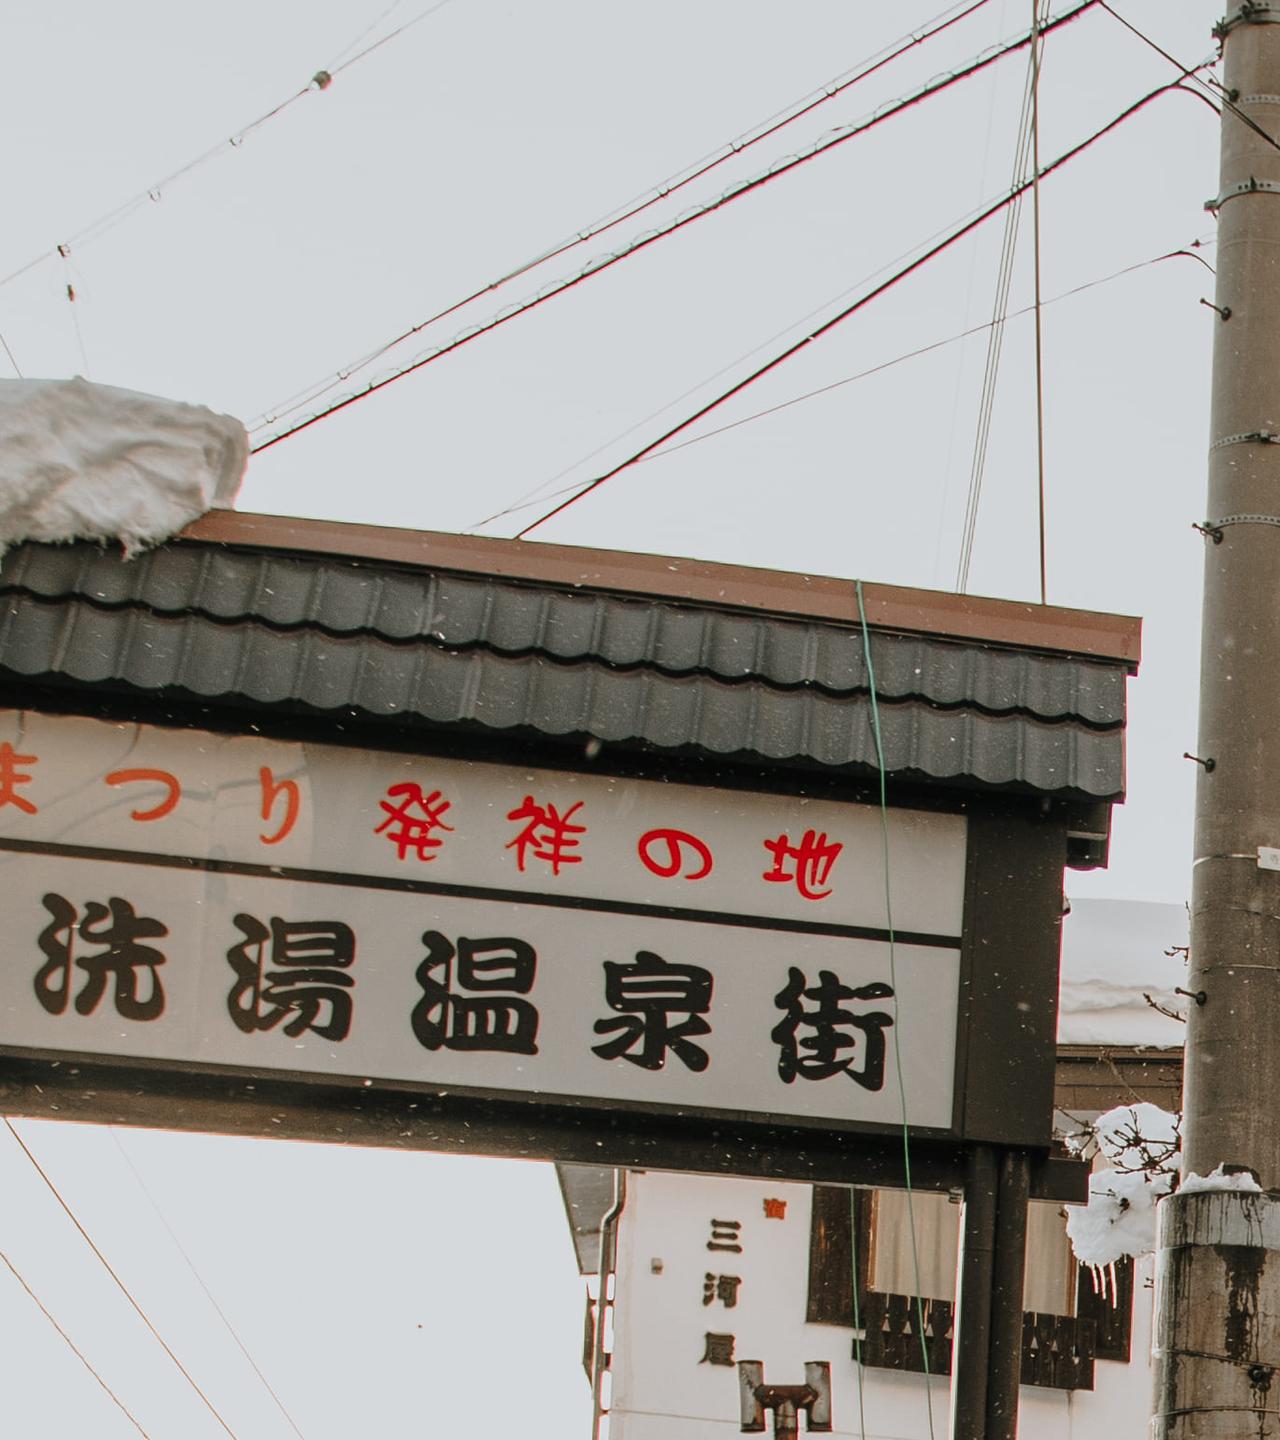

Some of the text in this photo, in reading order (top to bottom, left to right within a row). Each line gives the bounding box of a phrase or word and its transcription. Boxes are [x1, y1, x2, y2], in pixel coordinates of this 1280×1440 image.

[34, 893, 893, 1092] 洗湯温泉街
